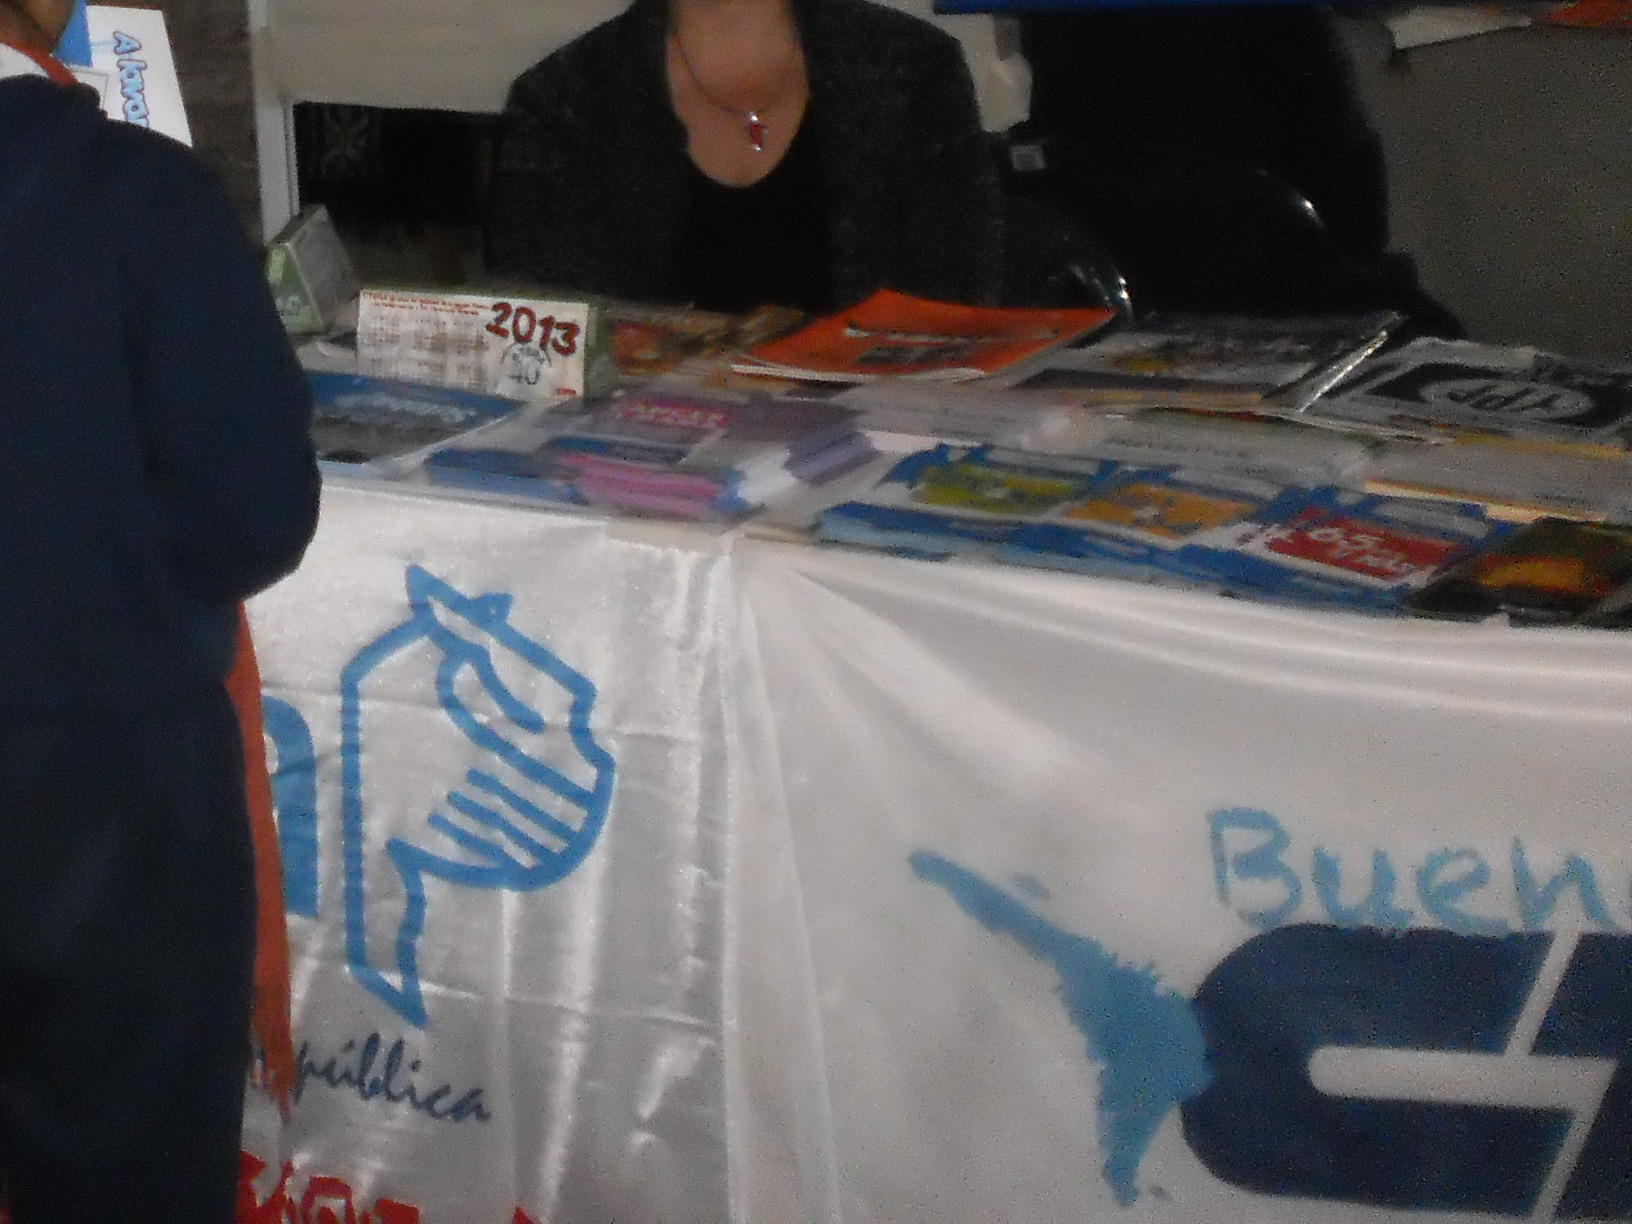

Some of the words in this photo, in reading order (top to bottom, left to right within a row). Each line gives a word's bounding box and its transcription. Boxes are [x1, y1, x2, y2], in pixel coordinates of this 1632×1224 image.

[484, 299, 581, 357] 2013
[1206, 804, 1632, 932] Buen
[292, 1032, 491, 1123] pública
